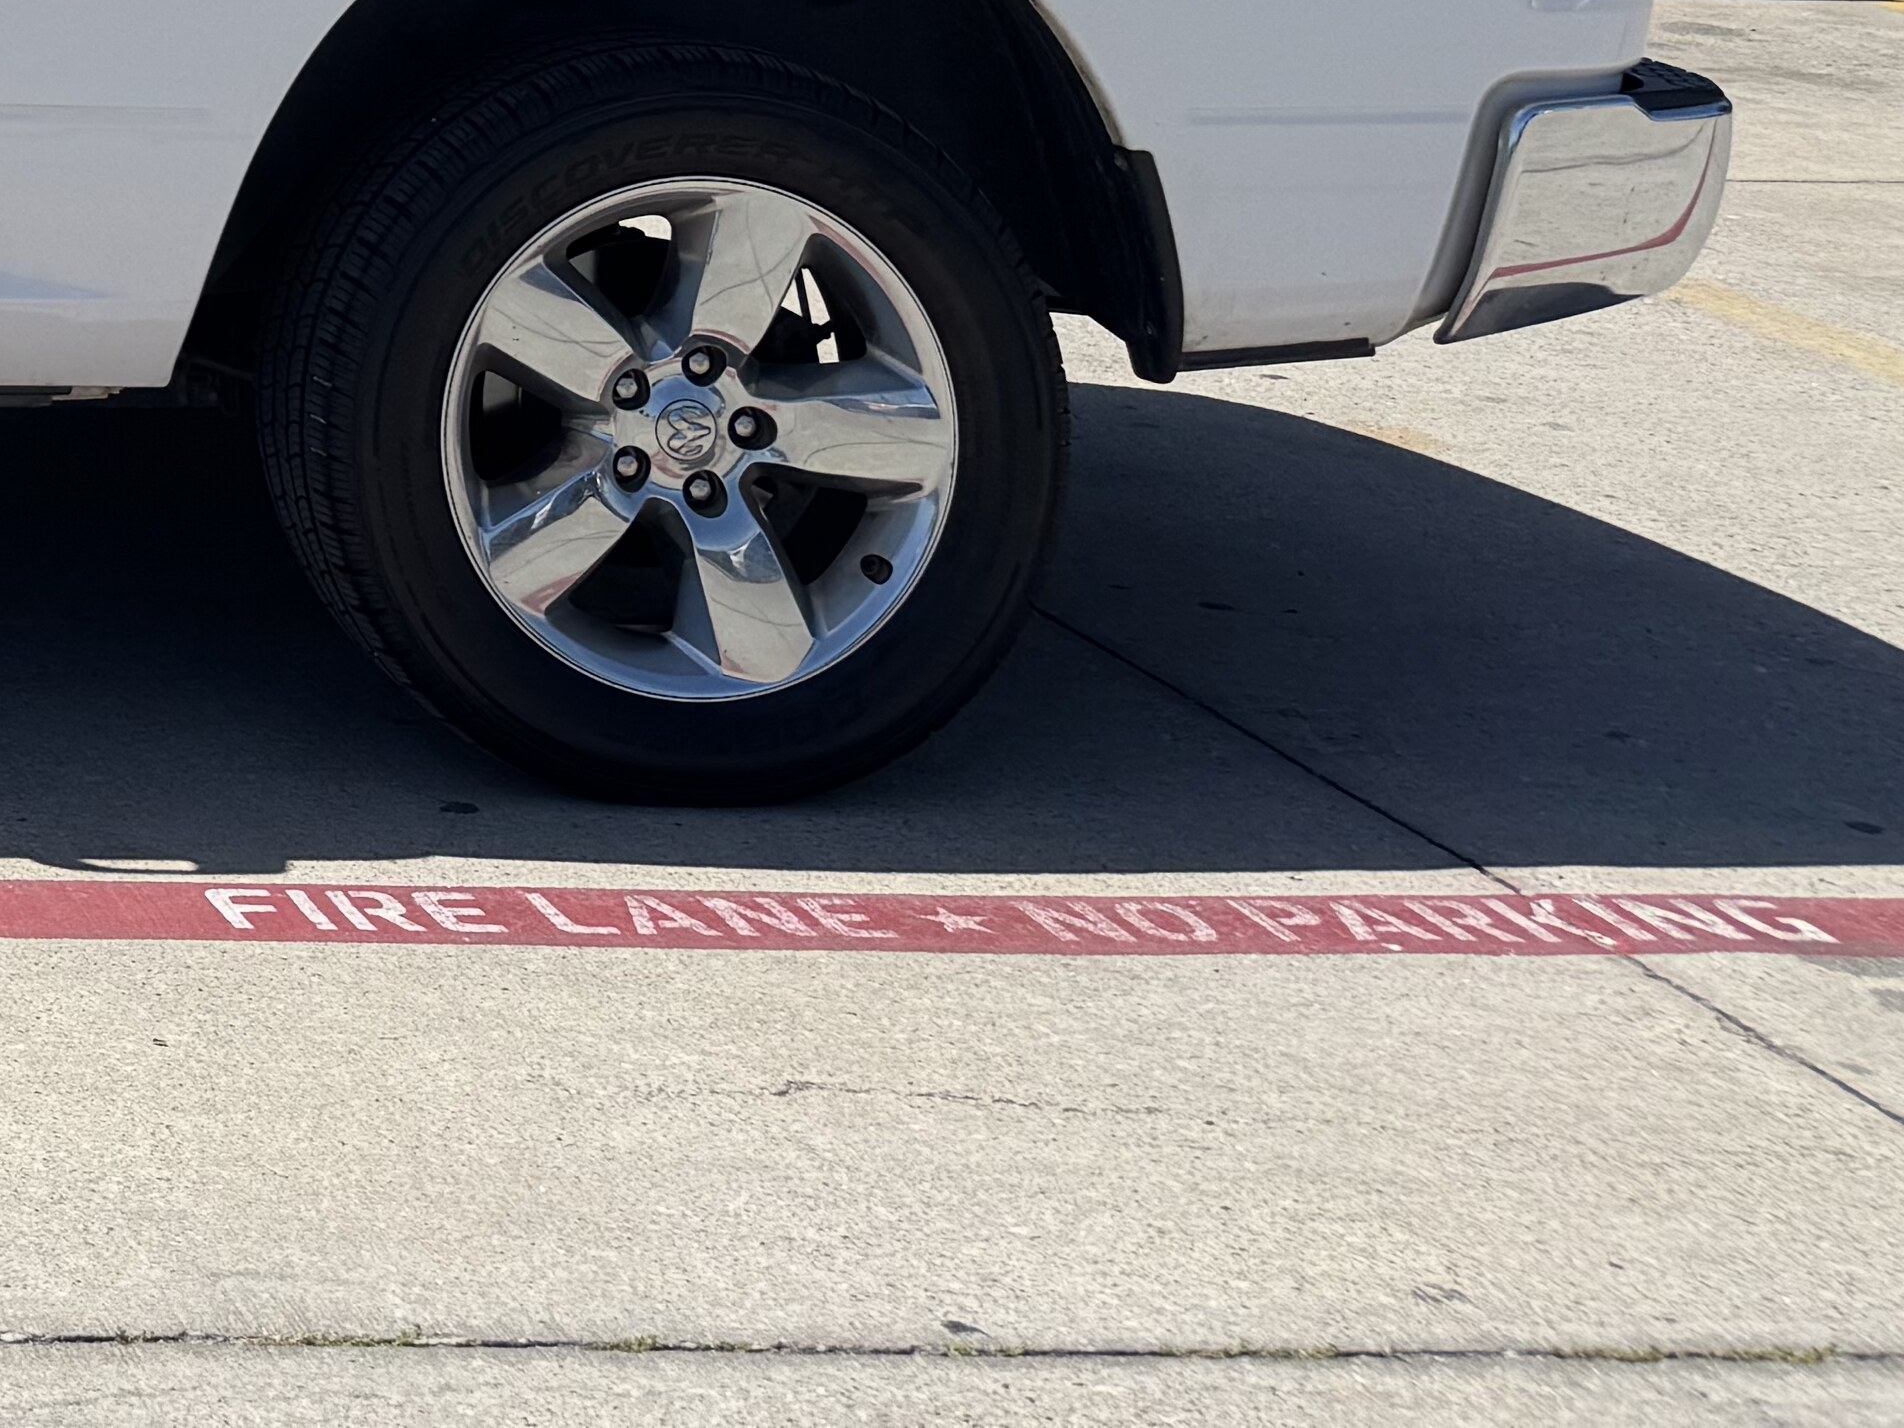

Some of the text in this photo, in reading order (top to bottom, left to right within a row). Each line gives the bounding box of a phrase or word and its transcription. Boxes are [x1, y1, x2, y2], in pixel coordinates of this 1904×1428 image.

[460, 132, 793, 278] DISCOVERER
[203, 886, 1842, 946] FIRE LANE NO PARKING
